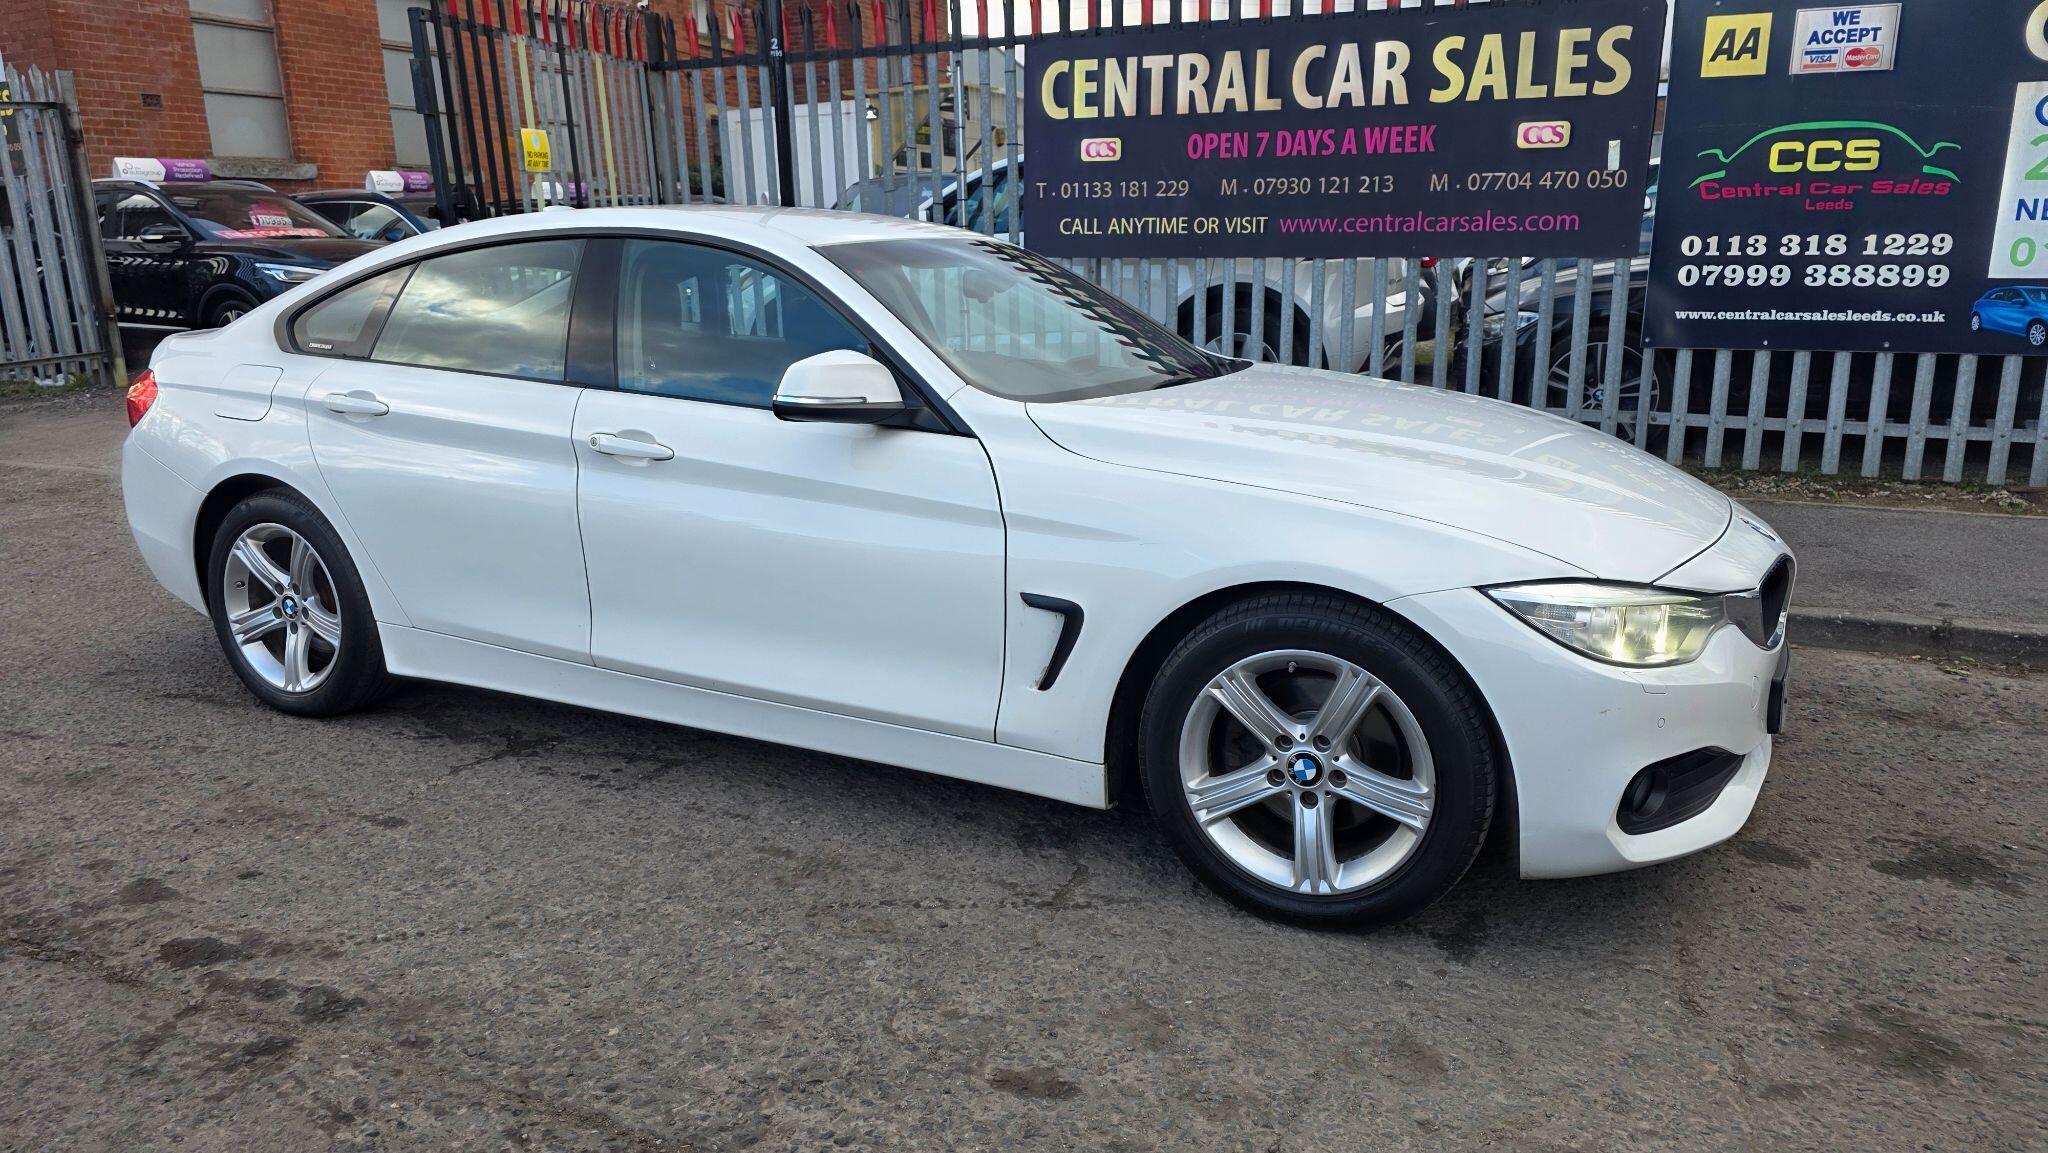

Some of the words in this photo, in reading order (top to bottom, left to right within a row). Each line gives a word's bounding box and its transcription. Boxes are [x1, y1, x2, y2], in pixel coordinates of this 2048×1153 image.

[1832, 10, 1861, 26] WE
[1709, 27, 1761, 62] AA
[1807, 27, 1882, 45] ACCEPT
[1809, 54, 1832, 64] VISA
[1041, 49, 1281, 119] CENTRAL
[1292, 40, 1411, 109] CAR
[1429, 25, 1634, 103] SALES
[1187, 132, 1249, 160] OPEN
[1256, 132, 1270, 157] 7
[1276, 129, 1335, 157] DAYS
[1340, 128, 1358, 155] A
[1364, 124, 1437, 153] WEEK
[1522, 124, 1565, 145] CCS
[1769, 139, 1880, 172] CCS
[1060, 182, 1112, 198] 01133
[1120, 181, 1148, 197] 181
[1155, 180, 1189, 197] 229
[1253, 177, 1311, 195] 07930
[1318, 176, 1348, 194] 121
[1359, 175, 1394, 193] 213
[1467, 172, 1532, 191] 07704
[1539, 171, 1580, 190] 470
[1587, 169, 1628, 188] 050
[1700, 181, 1800, 199] Central
[1809, 182, 1863, 195] Car
[1871, 178, 1951, 195] Sales
[1805, 198, 1853, 210] Leeds
[1060, 219, 1102, 235] CALL
[1108, 217, 1188, 235] ANYTIME
[1193, 217, 1219, 233] OR
[1225, 216, 1268, 233] VISIT
[1279, 210, 1579, 233] www.centralcarsales.com
[1681, 234, 1767, 257] 0113
[1779, 234, 1847, 256] 318
[1862, 233, 1954, 256] 1229
[1677, 264, 1791, 287] 07999
[1804, 264, 1950, 287] 388899
[1675, 309, 1945, 323] www.centralcarsalesleeds.co.uk
